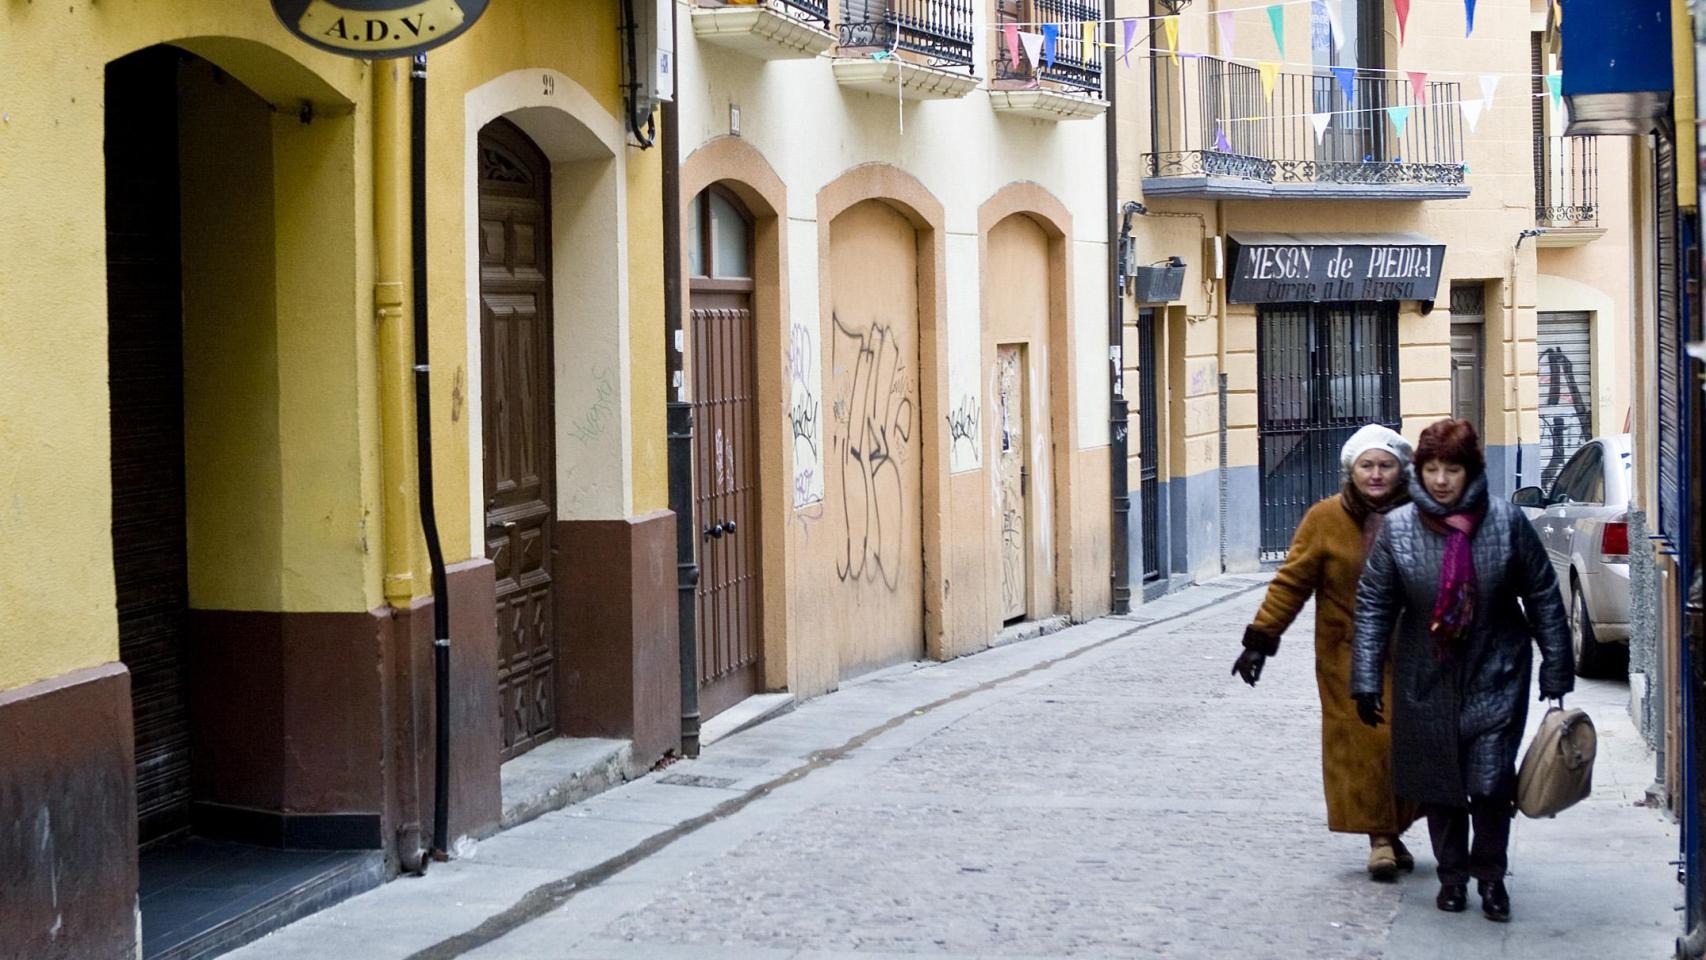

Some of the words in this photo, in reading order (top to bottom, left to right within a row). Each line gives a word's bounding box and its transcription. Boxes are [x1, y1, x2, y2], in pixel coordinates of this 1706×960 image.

[323, 12, 436, 42] A.D.V.
[1243, 246, 1315, 279] MESON
[1327, 246, 1354, 279] de
[1366, 246, 1432, 278] PIEDRA
